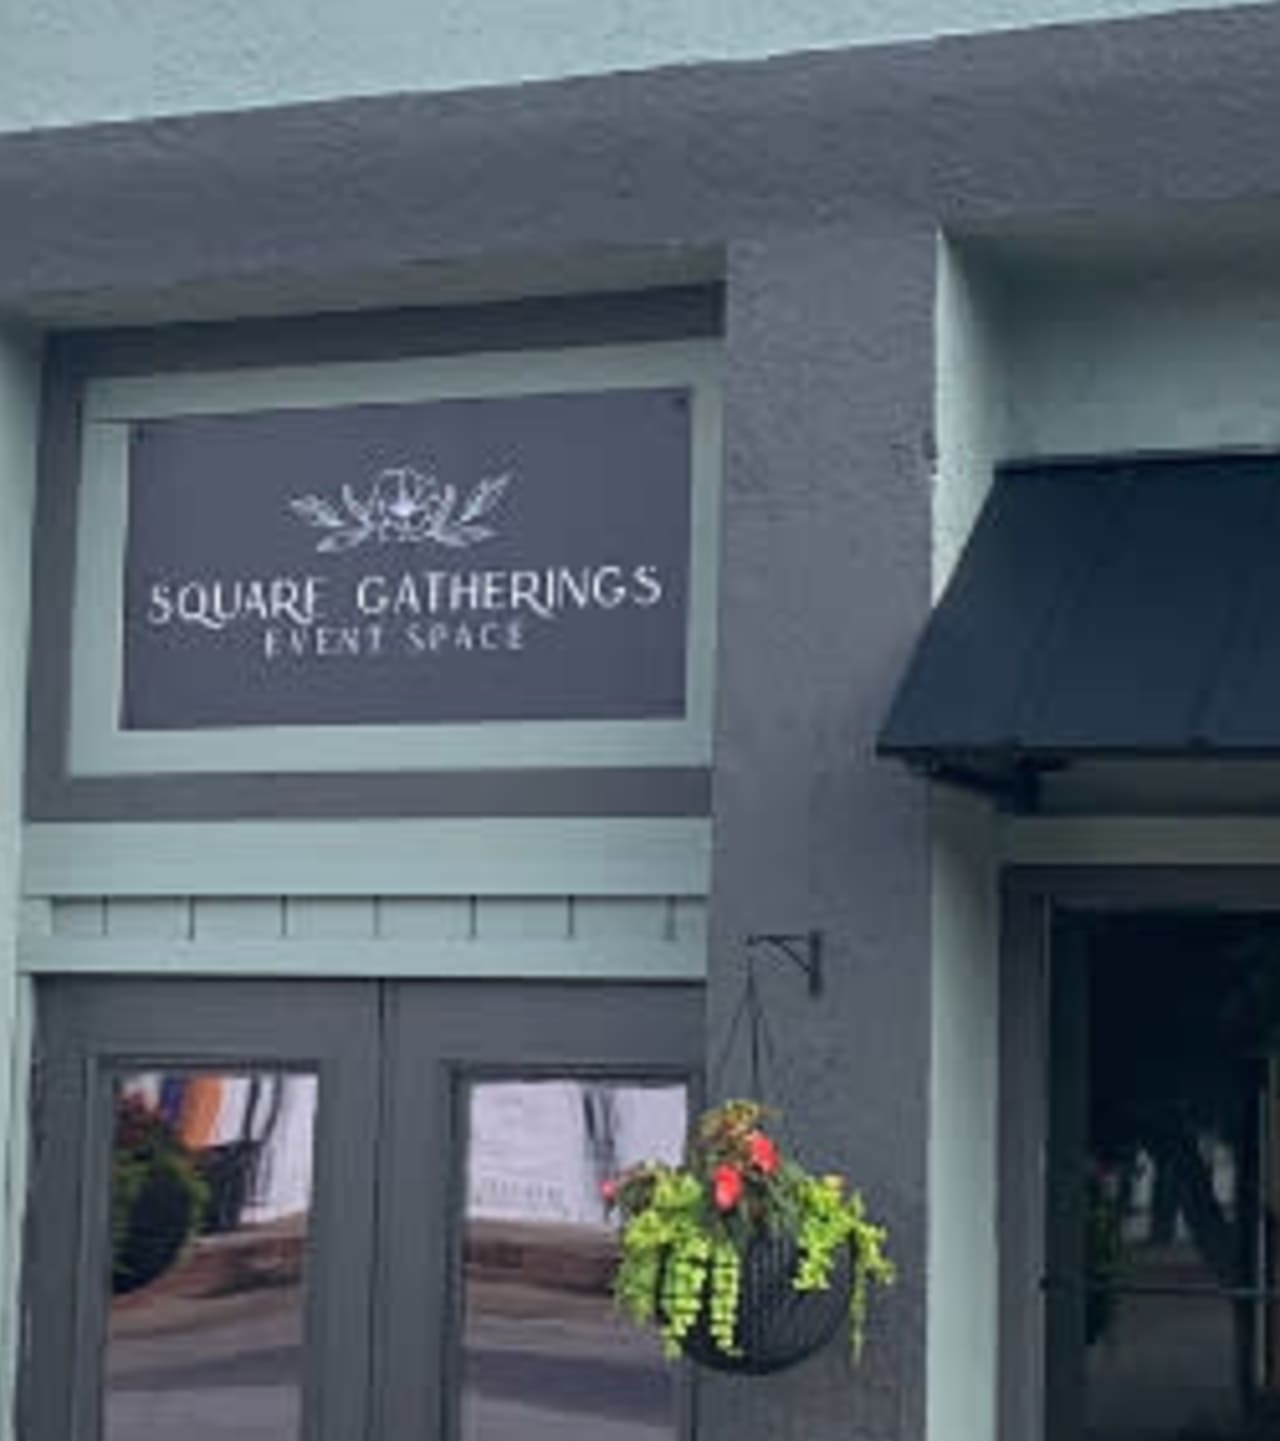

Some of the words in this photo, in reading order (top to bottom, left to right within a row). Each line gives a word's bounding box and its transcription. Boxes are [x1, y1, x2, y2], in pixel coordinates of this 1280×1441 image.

[147, 576, 330, 629] SQUARE
[356, 564, 663, 618] GATHERINGS
[264, 624, 384, 659] EVENT
[405, 620, 526, 651] SPACE
